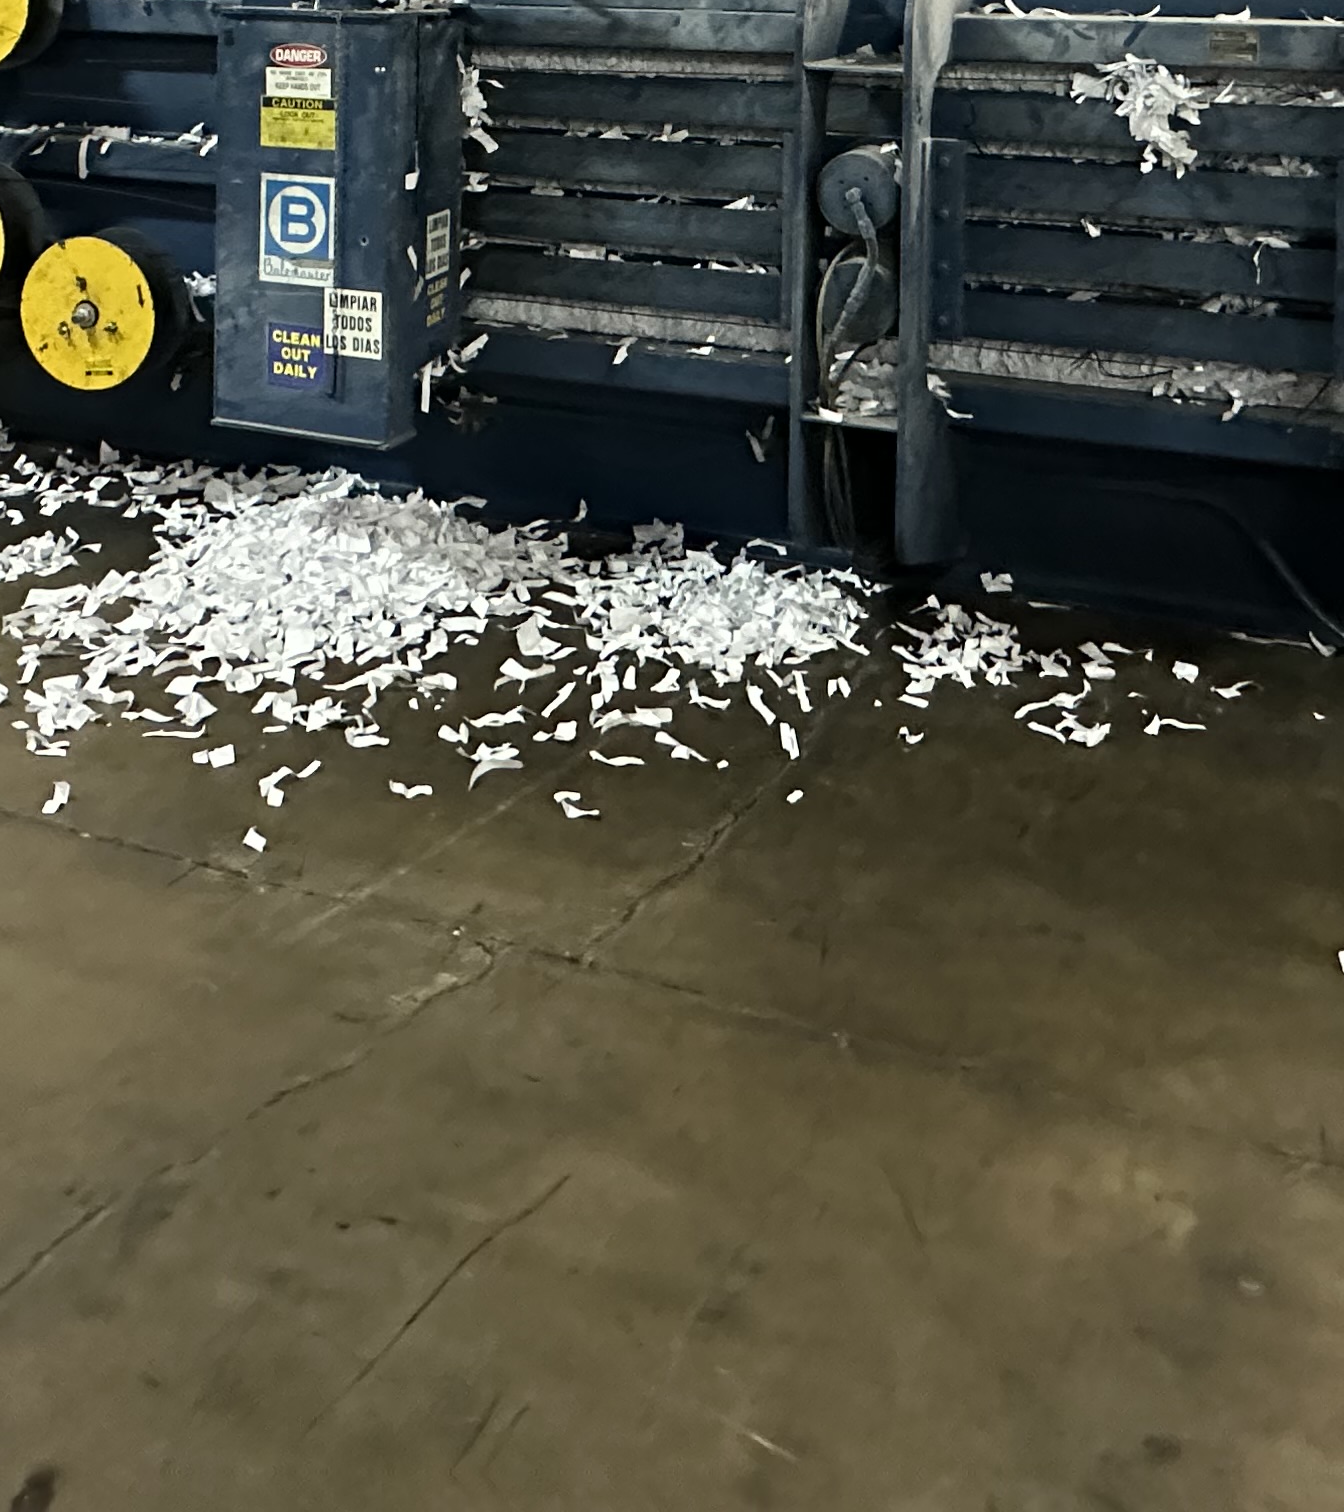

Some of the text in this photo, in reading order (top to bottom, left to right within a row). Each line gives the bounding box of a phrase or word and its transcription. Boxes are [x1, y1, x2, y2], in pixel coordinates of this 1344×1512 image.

[275, 48, 322, 63] DANGER
[271, 98, 323, 109] CAUTION
[279, 195, 317, 243] B
[329, 293, 377, 313] LIMPIAR
[334, 314, 372, 332] TODOS
[272, 329, 320, 348] CLEAN
[325, 333, 380, 355] LOS DIAS
[281, 347, 311, 363] OUT
[273, 361, 318, 380] DAILY
